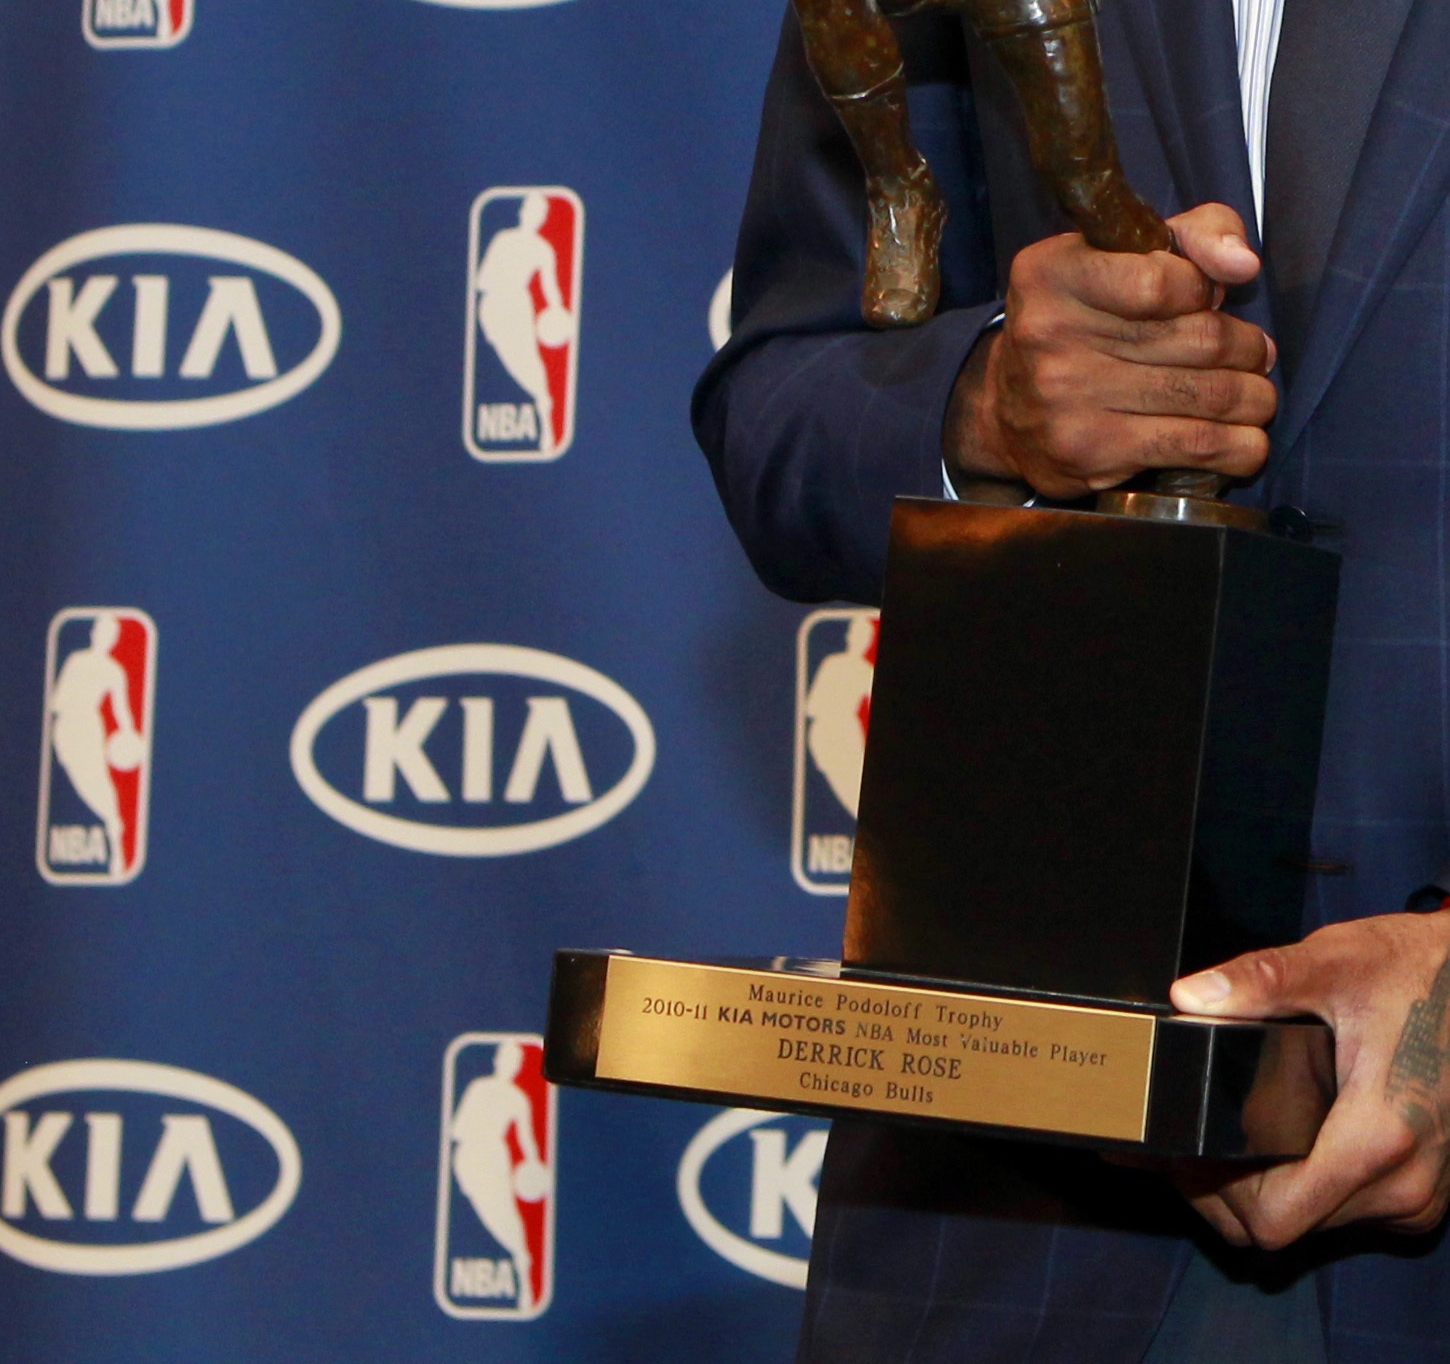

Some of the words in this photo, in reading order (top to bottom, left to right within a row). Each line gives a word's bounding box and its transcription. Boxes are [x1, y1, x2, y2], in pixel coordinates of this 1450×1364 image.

[46, 276, 278, 380] KIA
[478, 403, 537, 441] NBA
[364, 697, 592, 803] KIA
[50, 826, 107, 863] NBA
[808, 834, 855, 874] NB
[749, 983, 824, 1008] Maurice
[836, 993, 923, 1020] Podoloff
[936, 1004, 1004, 1032] Trophy
[642, 997, 708, 1021] 2010-11
[717, 1005, 754, 1025] KIA
[761, 1011, 846, 1036] MOTORS
[855, 1022, 894, 1042] NBA
[906, 1028, 949, 1048] Most
[960, 1033, 1040, 1059] Valuable
[1050, 1043, 1108, 1067] Player
[777, 1038, 886, 1071] DERRICK
[901, 1052, 962, 1080] ROSE
[799, 1071, 874, 1098] Chicago
[885, 1081, 934, 1104] Bulls
[2, 1112, 235, 1221] KIA
[451, 1259, 516, 1297] NBA
